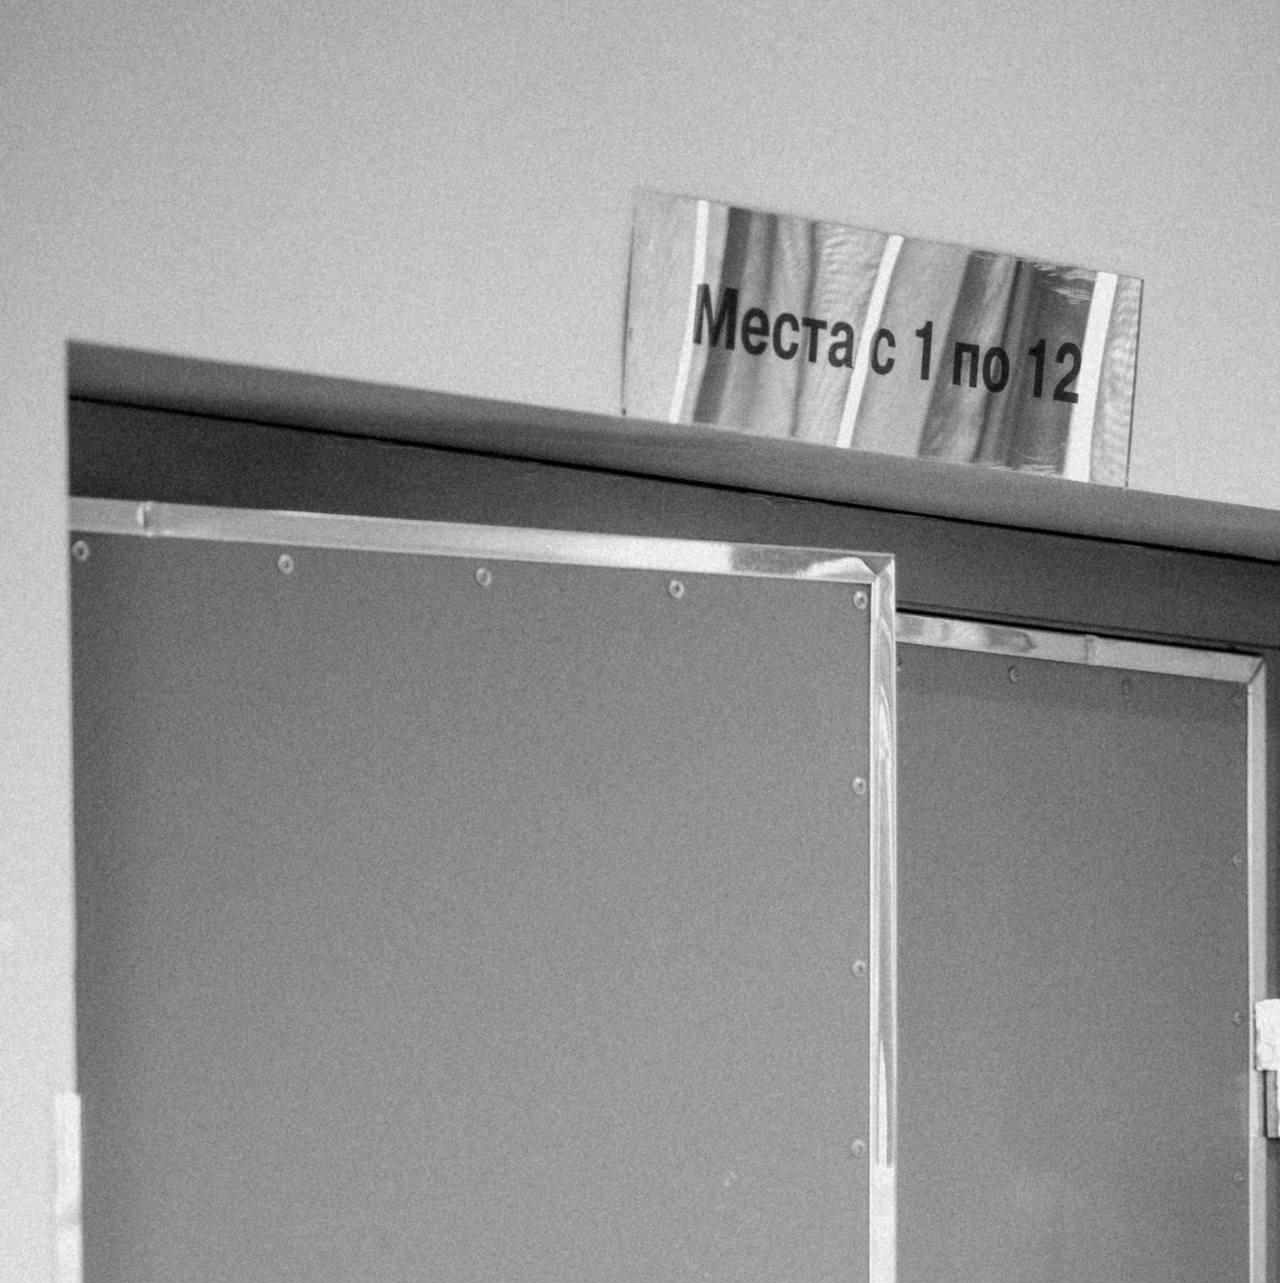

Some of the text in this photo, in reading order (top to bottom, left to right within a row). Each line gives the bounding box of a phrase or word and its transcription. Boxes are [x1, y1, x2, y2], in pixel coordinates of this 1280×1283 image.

[693, 283, 1083, 404] Места с 1 по 12
